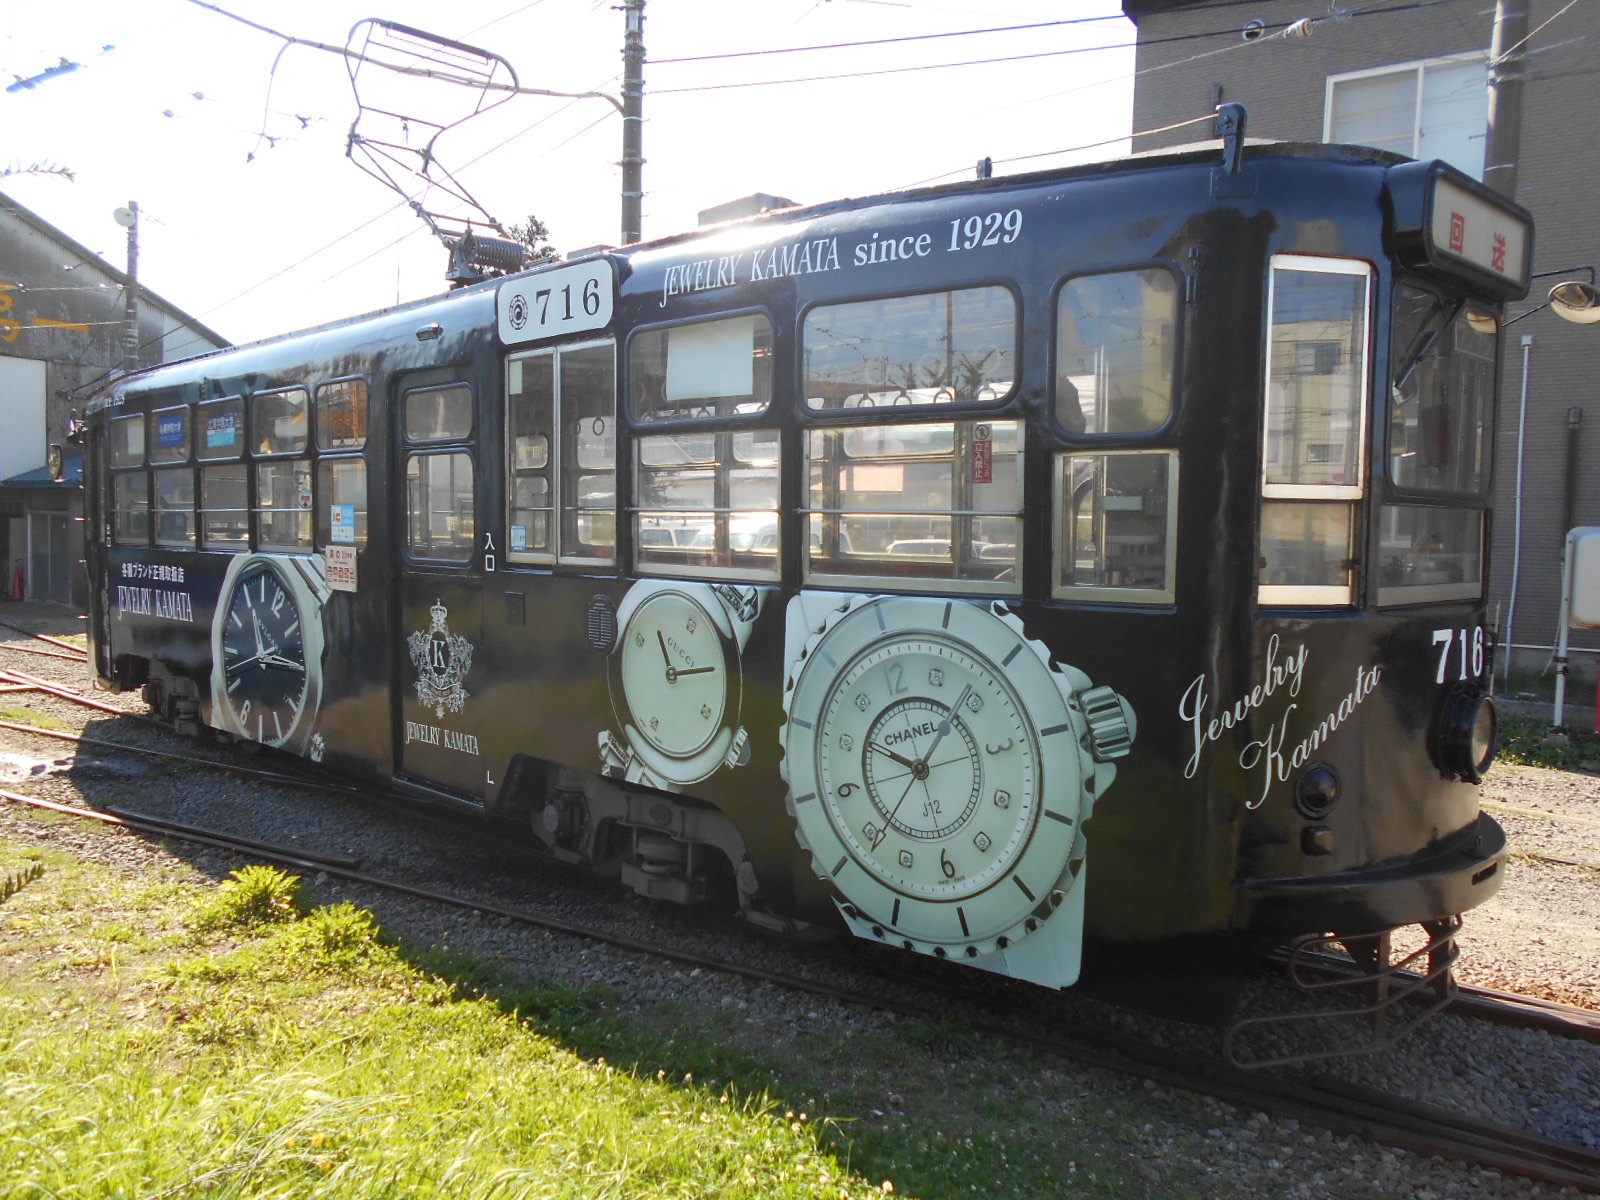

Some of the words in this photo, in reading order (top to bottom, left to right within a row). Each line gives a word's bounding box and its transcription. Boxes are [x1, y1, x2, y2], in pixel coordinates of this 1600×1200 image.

[659, 254, 743, 308] JEWELRY
[751, 237, 840, 283] KAMATA
[854, 232, 932, 268] since
[946, 208, 1024, 253] 1929
[1450, 211, 1507, 273] 回送
[535, 278, 600, 326] 716
[484, 532, 496, 572] 入口
[117, 585, 151, 621] JEWELRY
[155, 589, 194, 622] KAMATA
[432, 640, 447, 669] K
[667, 636, 696, 668] GUCCI
[1432, 625, 1484, 685] 716
[884, 661, 909, 697] 12
[1178, 633, 1309, 780] Jewelry
[406, 720, 441, 745] JEWELRY
[444, 729, 480, 756] KAMATA
[884, 721, 939, 747] CHANEL
[1239, 664, 1382, 810] Kamata
[922, 799, 943, 818] J12
